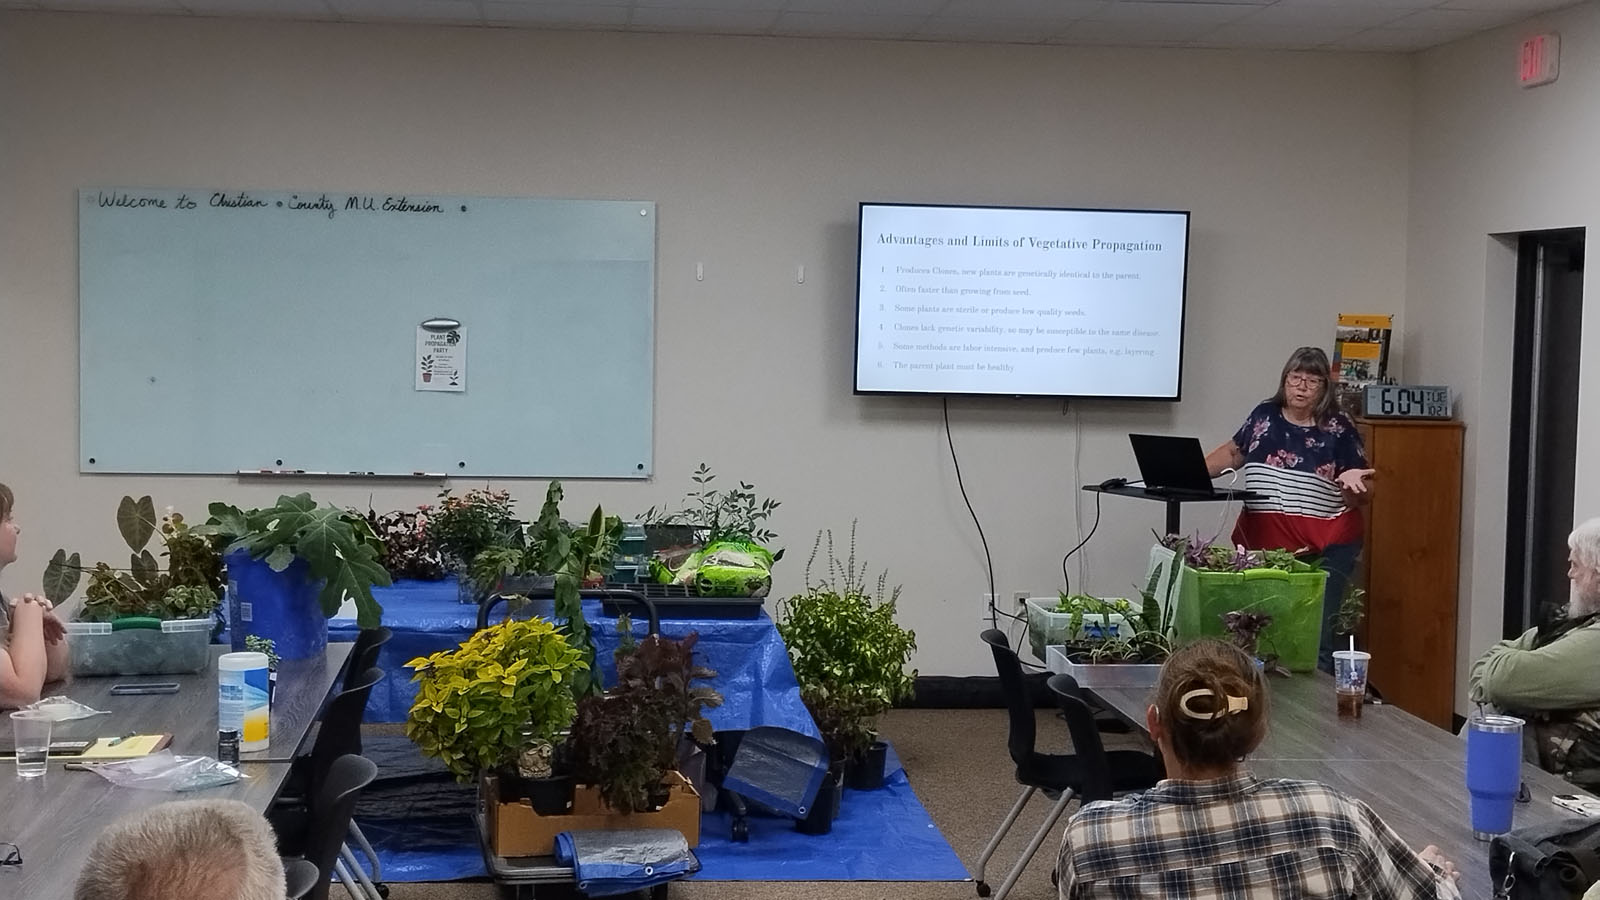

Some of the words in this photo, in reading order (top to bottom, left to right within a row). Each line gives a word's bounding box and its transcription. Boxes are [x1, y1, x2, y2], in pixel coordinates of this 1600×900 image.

[99, 191, 167, 209] Welcome
[175, 194, 197, 210] to
[288, 194, 338, 219] County
[382, 196, 444, 213] Extension
[877, 233, 944, 248] Advantages
[947, 235, 968, 246] and
[973, 235, 1009, 247] Limits
[1013, 236, 1025, 248] of
[1029, 237, 1088, 251] Vegetative
[1092, 238, 1163, 253] Propagation
[896, 266, 930, 275] Produces
[979, 268, 1002, 277] plants
[1018, 270, 1057, 279] genetically
[1059, 270, 1090, 279] identical
[1092, 271, 1100, 279] to
[895, 285, 916, 293] Often
[918, 286, 940, 294] faster
[941, 286, 959, 294] than
[960, 287, 991, 297] growing
[993, 287, 1011, 295] from
[894, 304, 915, 313] Some
[917, 305, 940, 314] plants
[956, 305, 979, 314] sterile
[991, 306, 1020, 316] produce
[1036, 308, 1062, 318] quality
[894, 323, 919, 331] Clones
[920, 323, 935, 332] lack
[937, 325, 964, 333] genetic
[1018, 328, 1033, 336] may
[1046, 327, 1086, 336] susceptible
[893, 343, 914, 351] Some
[916, 343, 947, 351] methods
[963, 343, 982, 352] labor
[1036, 346, 1066, 354] produce
[893, 361, 908, 369] The
[909, 362, 933, 371] parent
[935, 362, 954, 371] plant
[977, 362, 986, 370] be
[987, 362, 1015, 372] healthy
[1426, 391, 1447, 403] TUE
